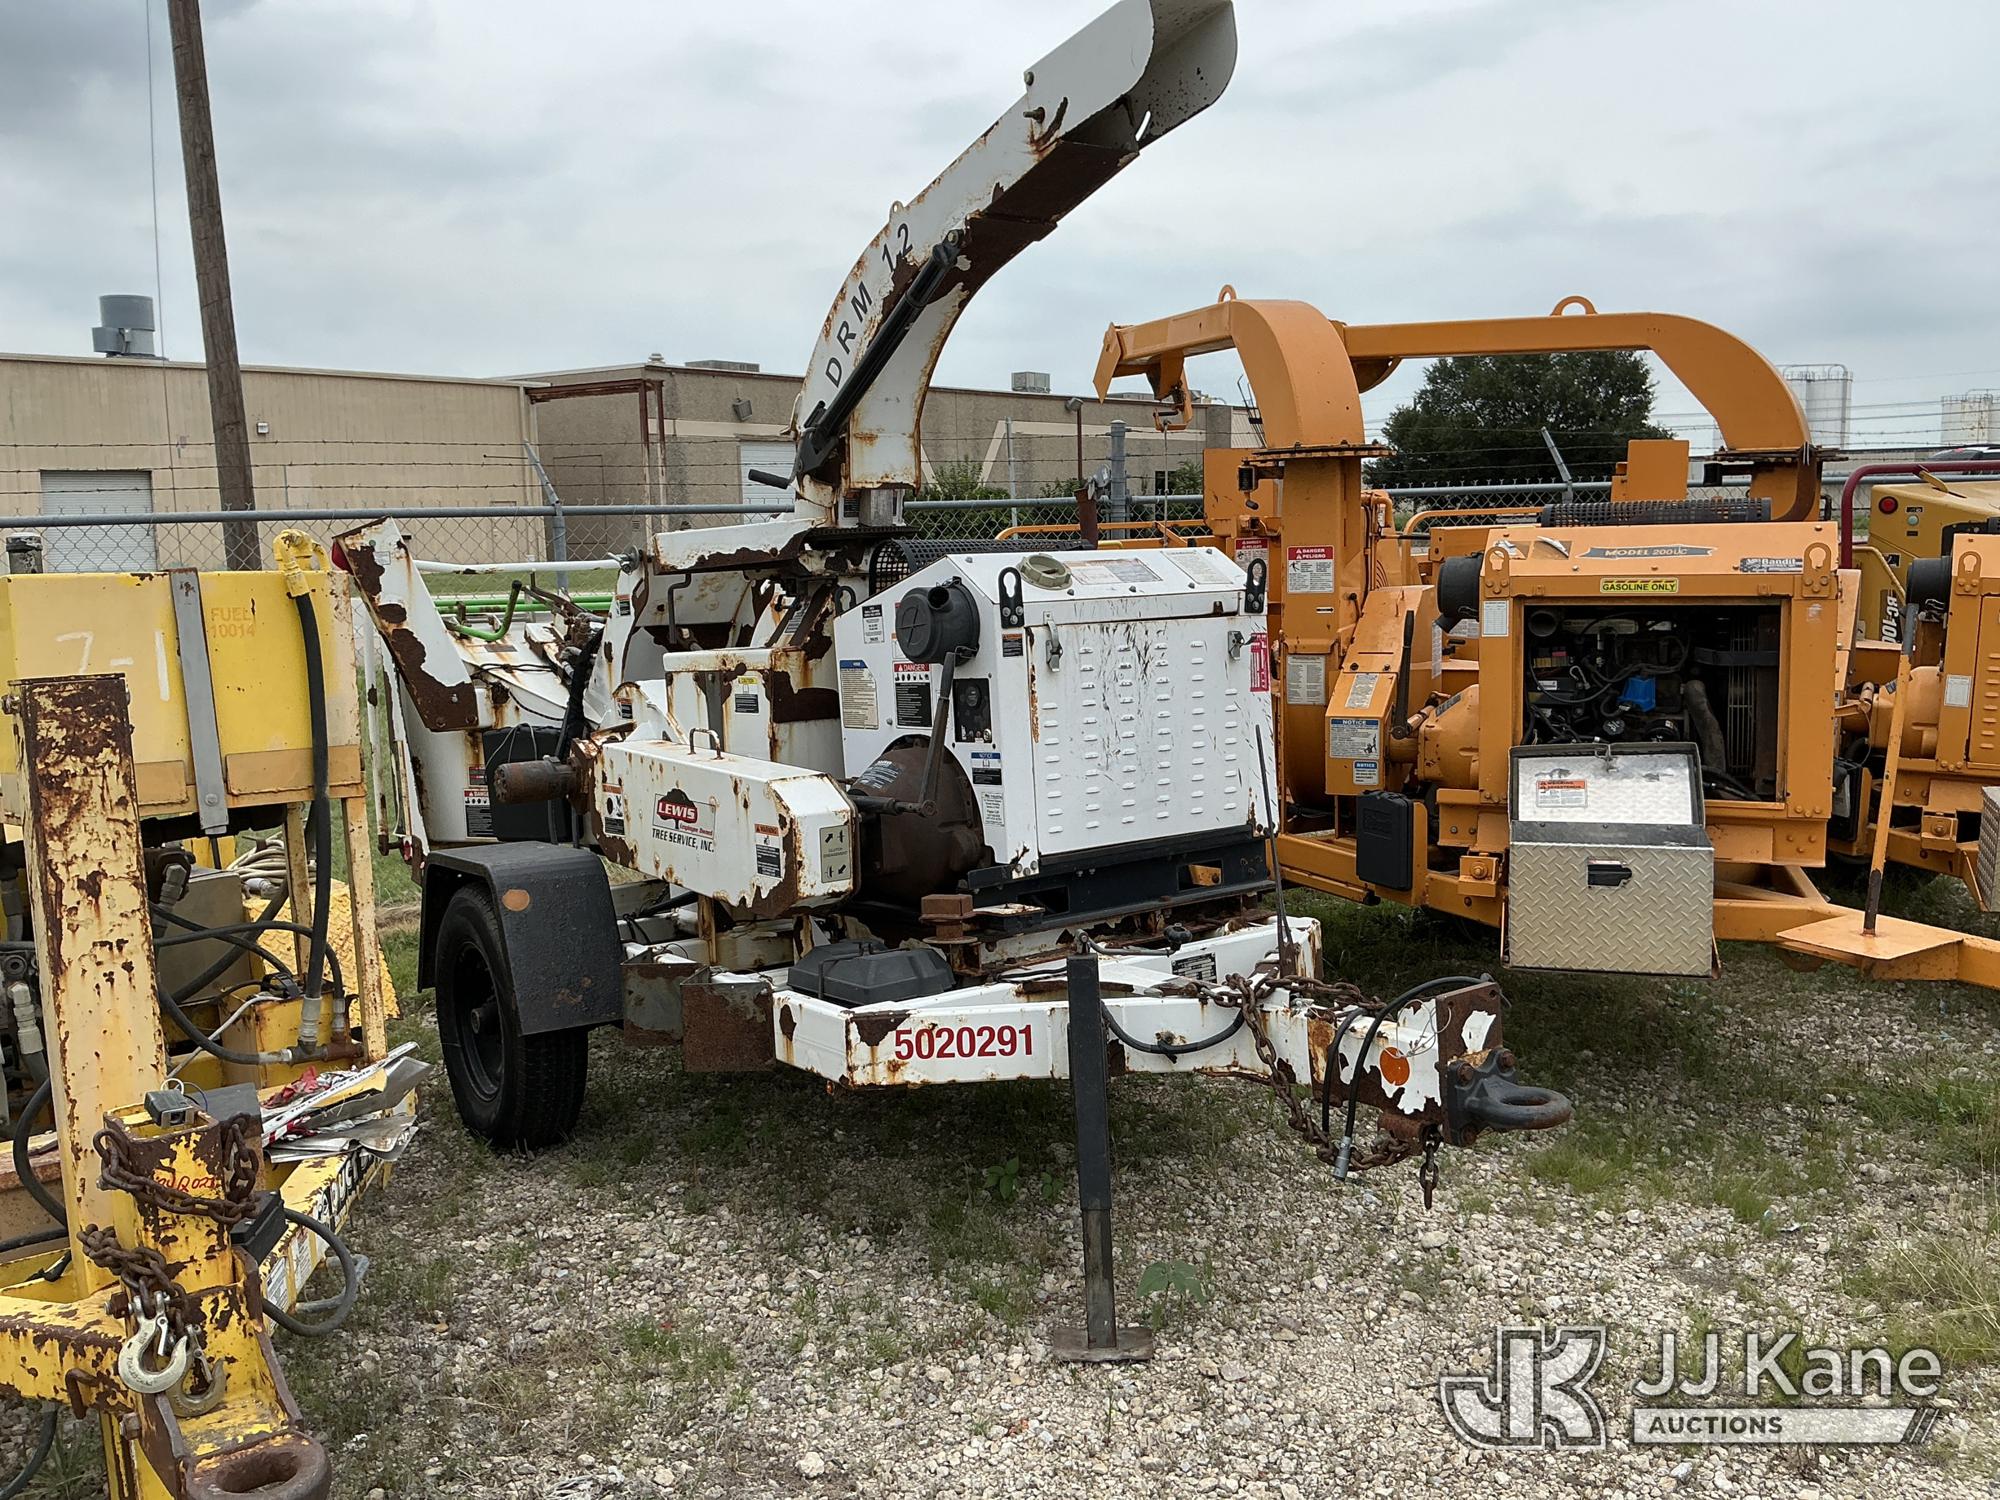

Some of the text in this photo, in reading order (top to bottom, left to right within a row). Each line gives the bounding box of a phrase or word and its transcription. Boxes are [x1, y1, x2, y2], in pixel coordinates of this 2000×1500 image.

[1602, 583, 1676, 591] GASOLINE ONLY
[211, 607, 253, 622] FUEL
[211, 623, 255, 638] 10014
[903, 663, 926, 671] DANGER
[658, 802, 696, 820] LEWIS
[652, 828, 715, 853] TREE SERVICE, INC.
[894, 1024, 1033, 1061] 5020291
